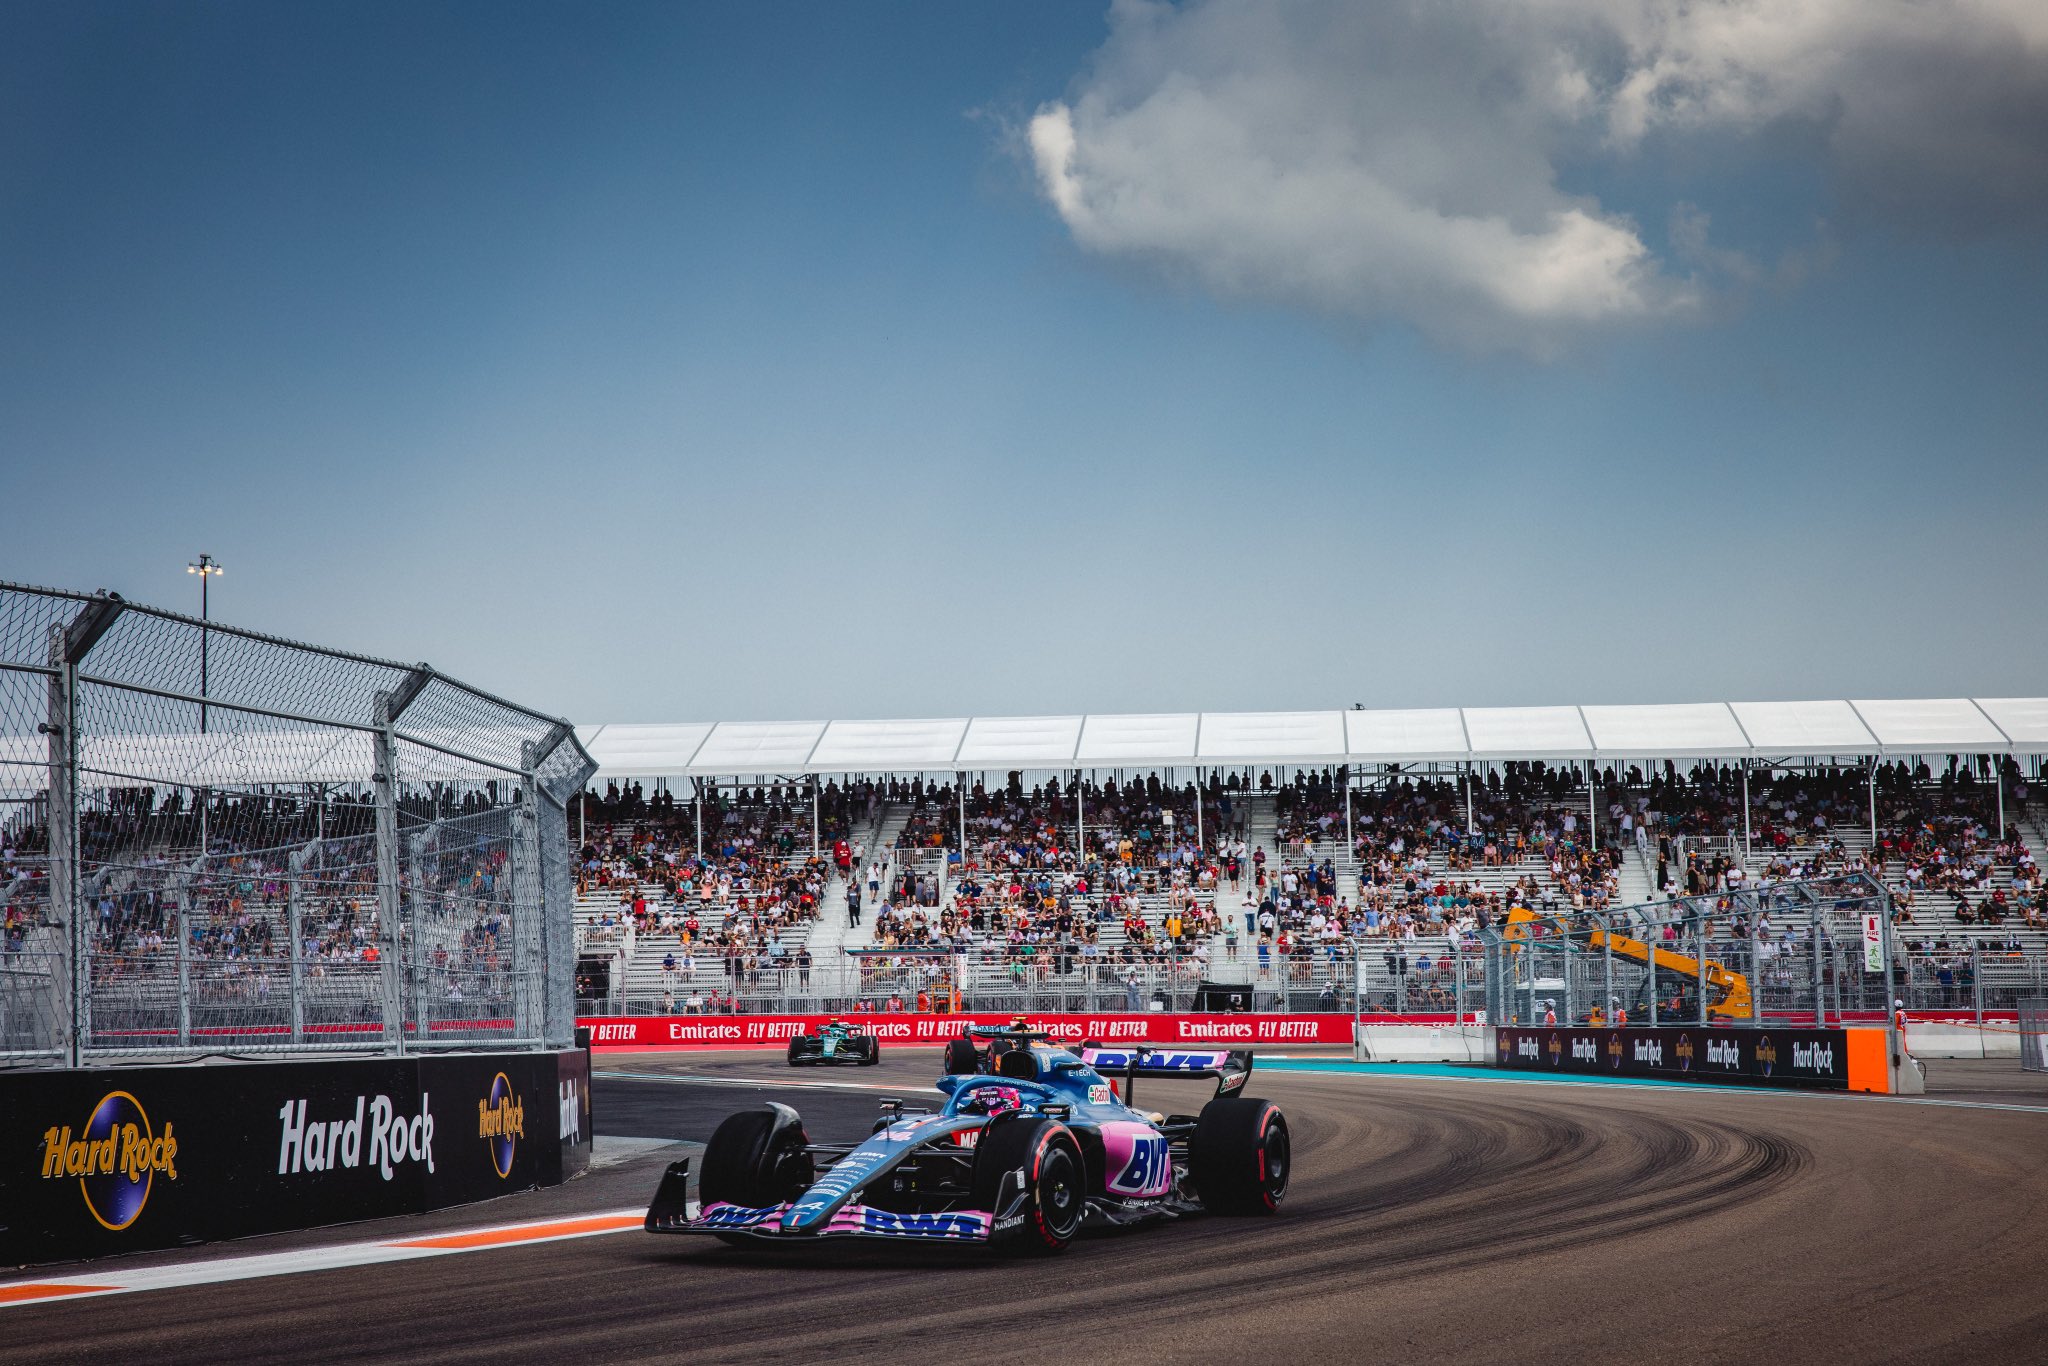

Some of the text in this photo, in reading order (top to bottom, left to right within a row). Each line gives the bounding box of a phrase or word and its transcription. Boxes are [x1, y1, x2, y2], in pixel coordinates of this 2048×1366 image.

[598, 1024, 637, 1040] BETTER
[669, 1022, 806, 1039] Emirates FLY BETTER
[917, 1021, 937, 1037] FLY
[1088, 1021, 1109, 1037] FLY
[1109, 1021, 1148, 1037] BETTER
[1179, 1020, 1319, 1038] Emirates FLY BETTER
[1634, 1039, 1662, 1066] Hard Rock
[1707, 1038, 1740, 1069] Hard Rock
[1793, 1041, 1833, 1074] Hard Rock
[479, 1095, 524, 1142] Hard Rock
[278, 1092, 434, 1181] Hard Rock
[41, 1122, 177, 1183] Hard Rock
[1111, 1135, 1168, 1193] BWT
[864, 1208, 984, 1239] BWT
[994, 1214, 1025, 1232] MANDIANT
